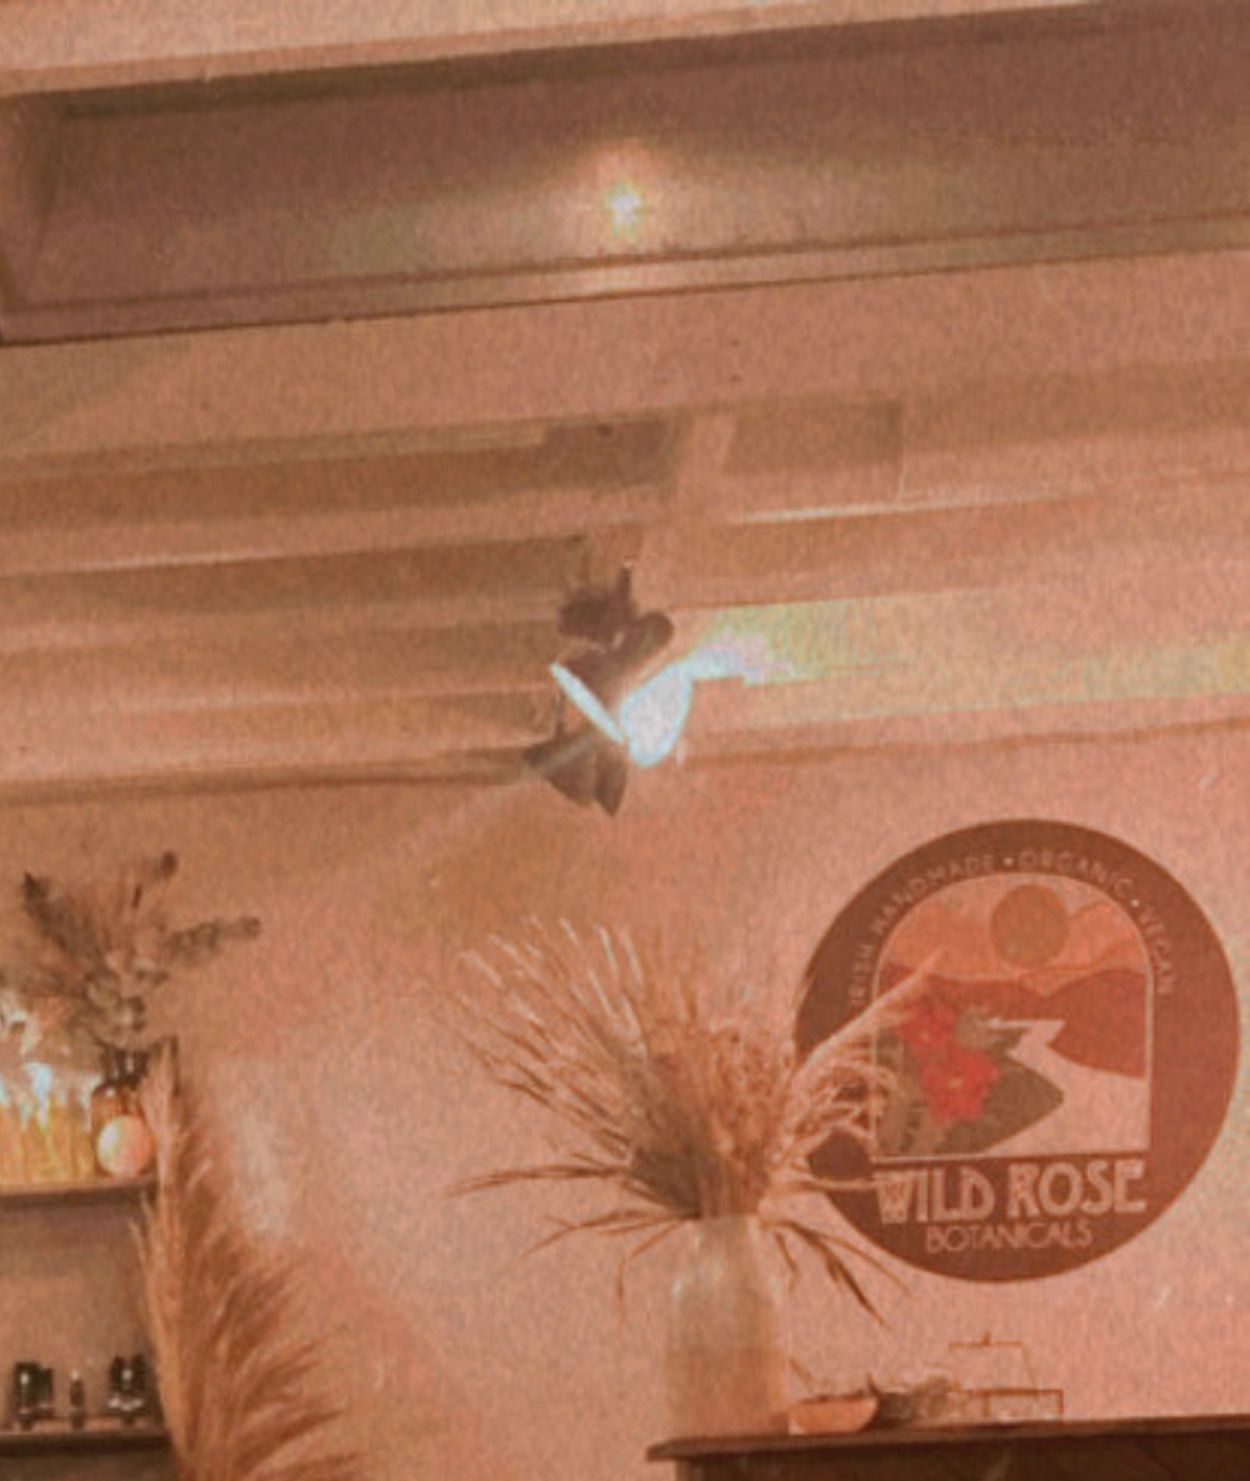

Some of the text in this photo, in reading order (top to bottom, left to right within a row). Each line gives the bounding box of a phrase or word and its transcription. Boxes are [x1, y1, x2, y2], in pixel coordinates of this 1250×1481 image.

[869, 854, 994, 936] HANDMADE
[1018, 848, 1133, 898] ORGANIC
[1138, 908, 1175, 995] VEGAN
[874, 1158, 1147, 1224] WILD ROSE
[925, 1219, 1093, 1254] BOTANICALS
